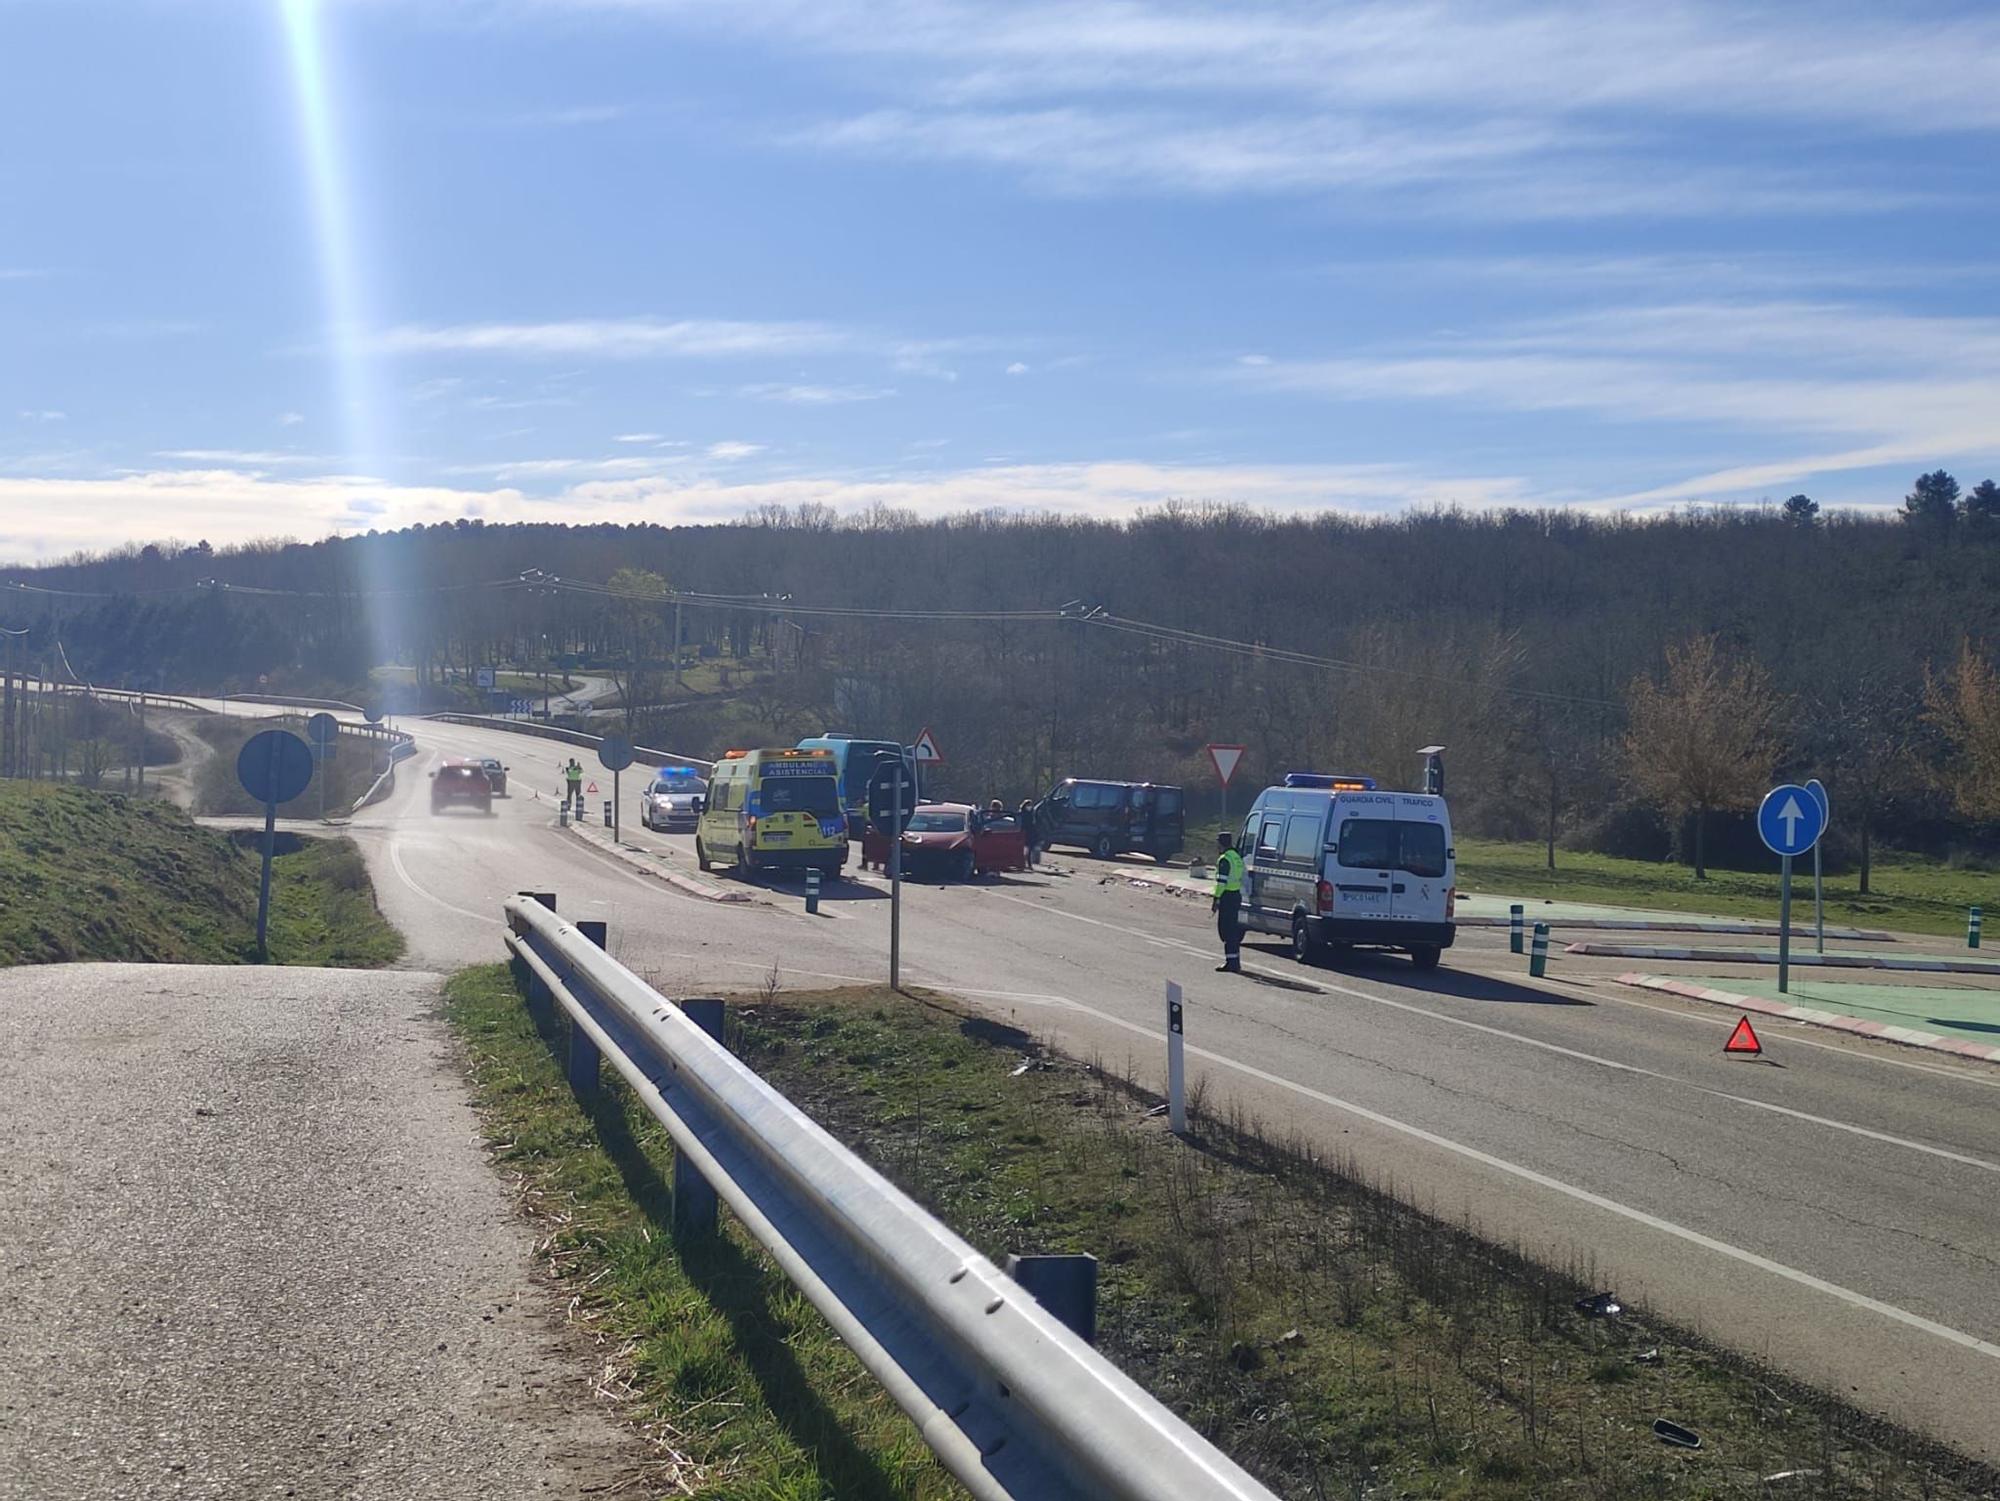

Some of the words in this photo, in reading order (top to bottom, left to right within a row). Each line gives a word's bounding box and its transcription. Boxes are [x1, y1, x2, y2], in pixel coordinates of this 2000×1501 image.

[1340, 795, 1374, 804] GUARDIA
[1375, 796, 1395, 805] CIVIL
[823, 826, 836, 835] 112
